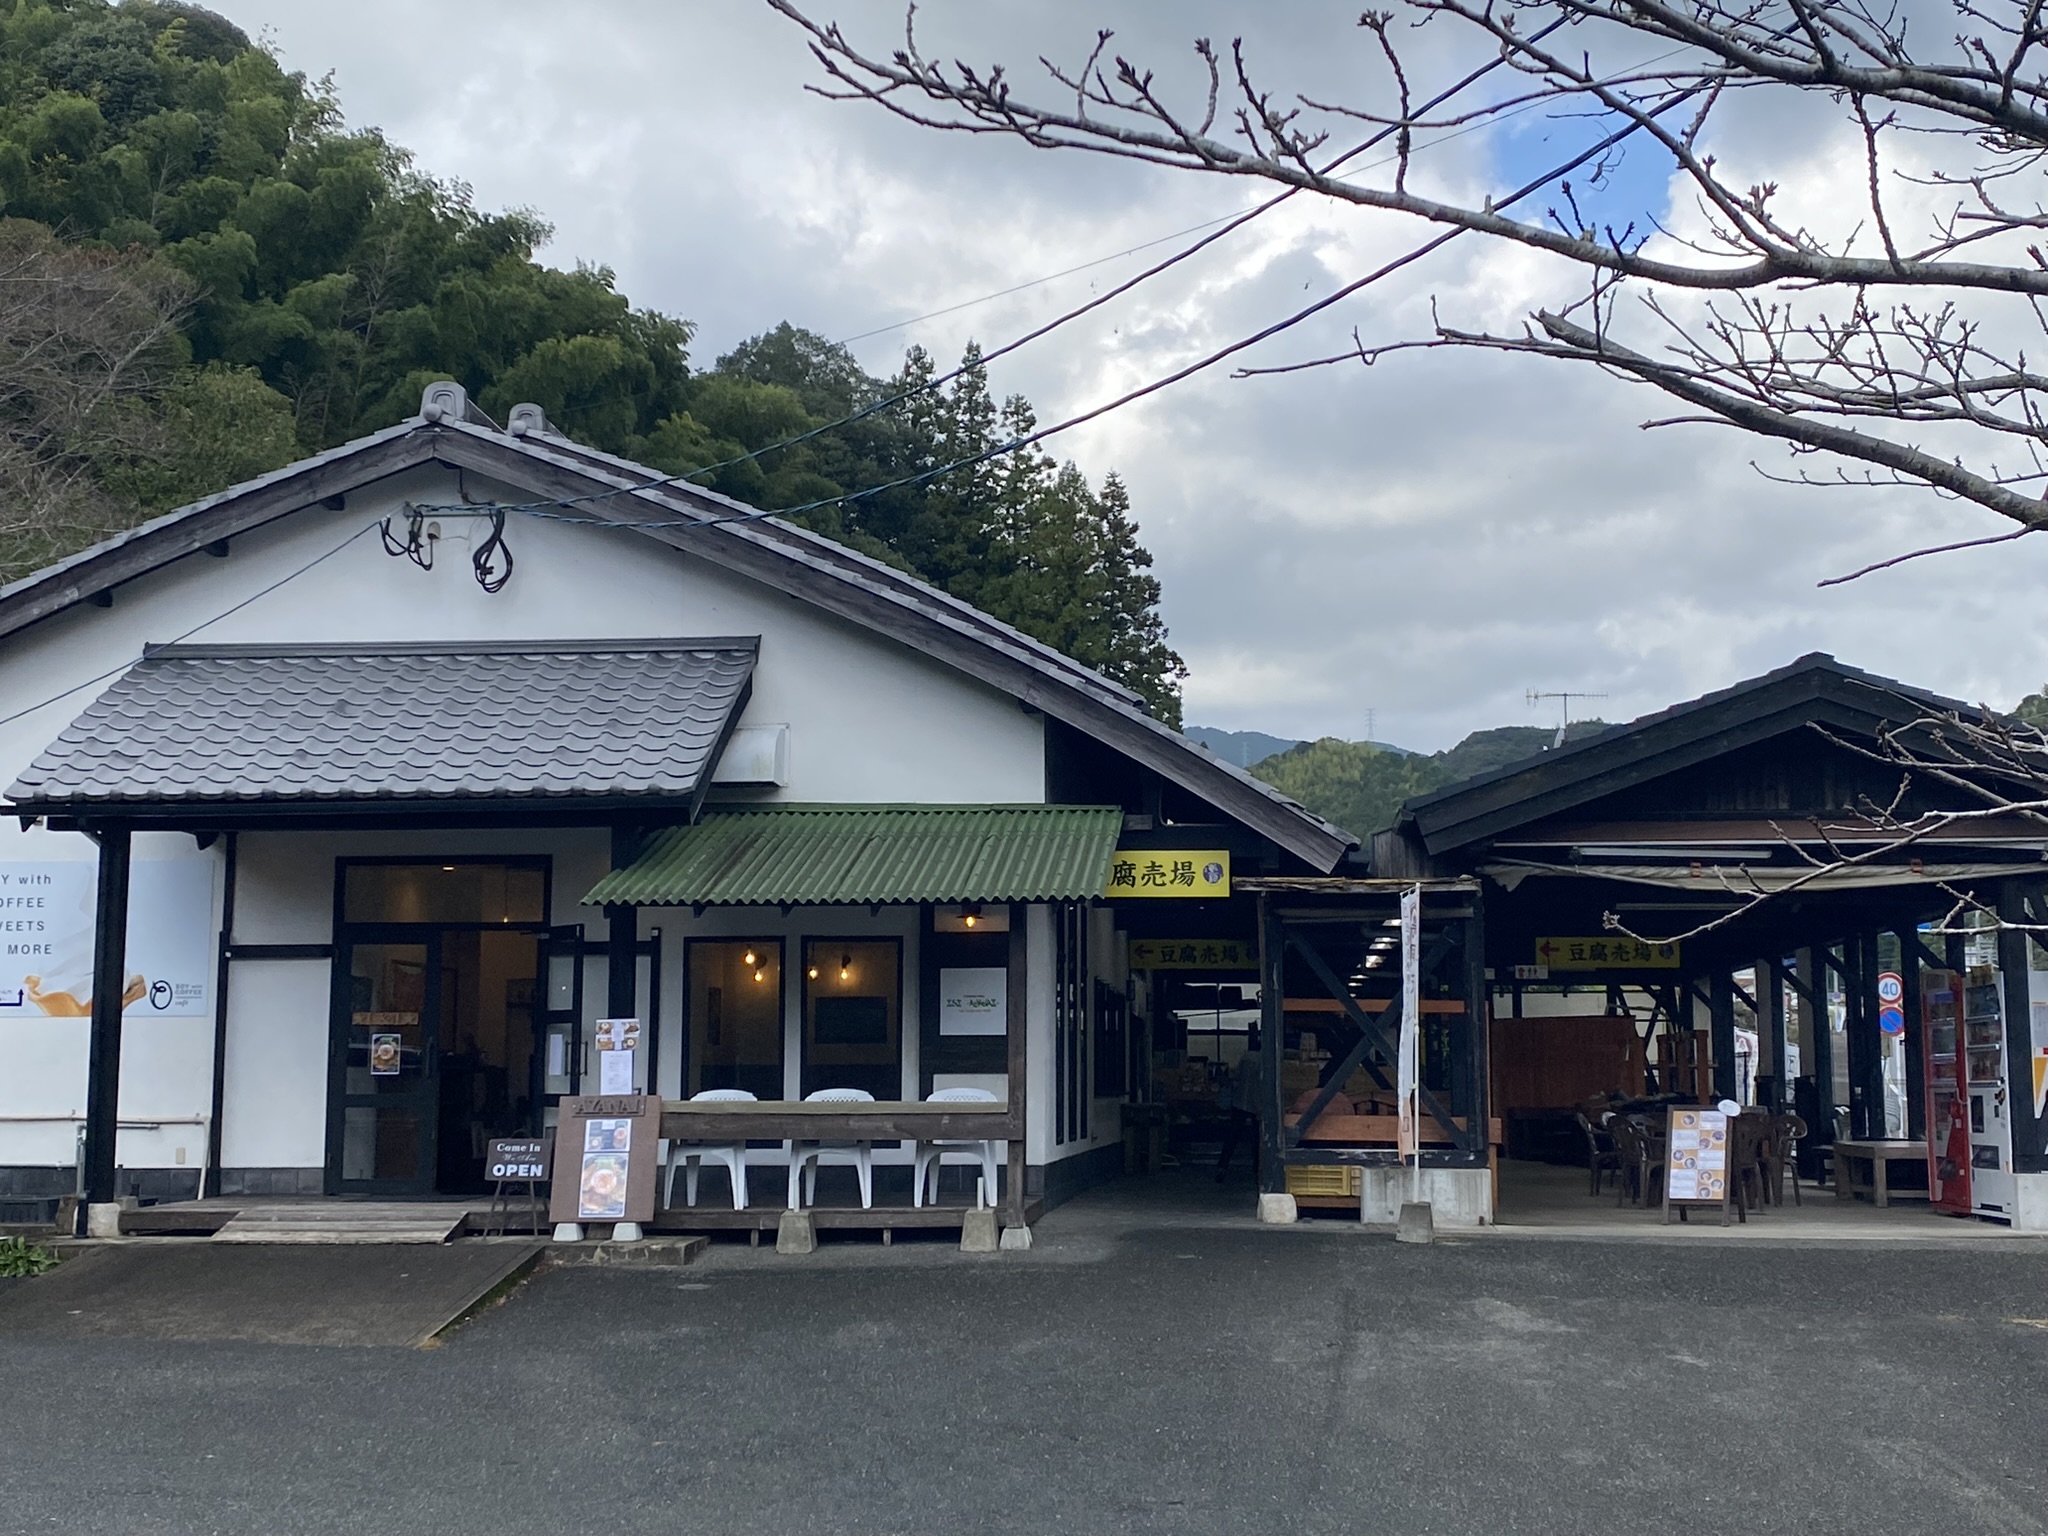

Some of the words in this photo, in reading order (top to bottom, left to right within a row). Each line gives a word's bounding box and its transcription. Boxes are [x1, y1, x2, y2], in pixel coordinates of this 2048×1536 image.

[19, 874, 52, 885] with
[1107, 860, 1196, 888] 腐売場
[0, 921, 45, 932] EETS
[7, 944, 52, 955] MORE
[1160, 944, 1239, 964] 豆腐売場
[1568, 942, 1652, 962] 豆腐売場
[1881, 982, 1899, 996] 40
[574, 1099, 641, 1115] AYANAI
[496, 1143, 527, 1152] Come
[529, 1143, 541, 1152] In
[492, 1163, 544, 1177] OPEN
